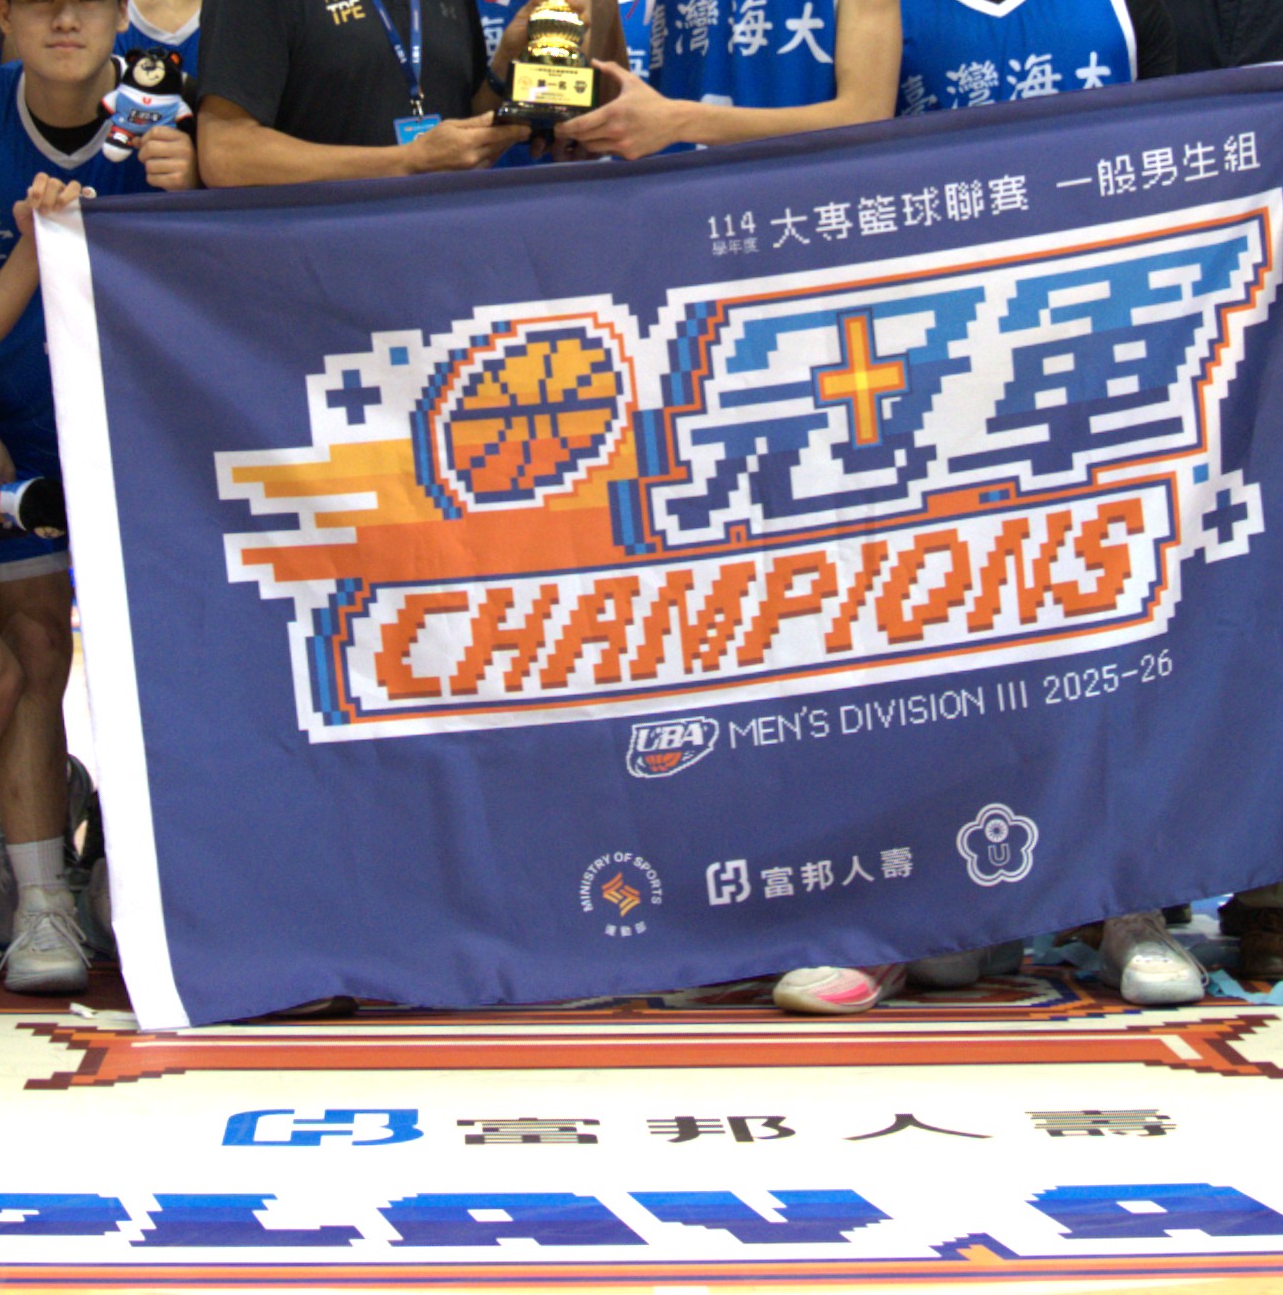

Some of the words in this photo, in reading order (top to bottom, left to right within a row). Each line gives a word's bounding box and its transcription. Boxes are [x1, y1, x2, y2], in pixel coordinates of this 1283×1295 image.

[706, 209, 758, 242] 114
[769, 172, 1030, 250] 大專籃球聯賽
[1054, 130, 1262, 197] 一般男生組
[710, 236, 761, 258] 學年度
[374, 495, 1146, 701] CHAMPIONS
[728, 708, 831, 749] MEN'S
[840, 688, 986, 736] DIVISION
[997, 680, 1029, 713] III
[1042, 649, 1174, 706] 2025-26
[635, 723, 708, 752] UBA
[579, 852, 612, 913] MINISTRY
[613, 851, 633, 864] OF
[632, 855, 663, 906] SPORTS
[759, 845, 914, 900] 富邦人壽
[454, 1107, 1178, 1147] 富邦人壽
